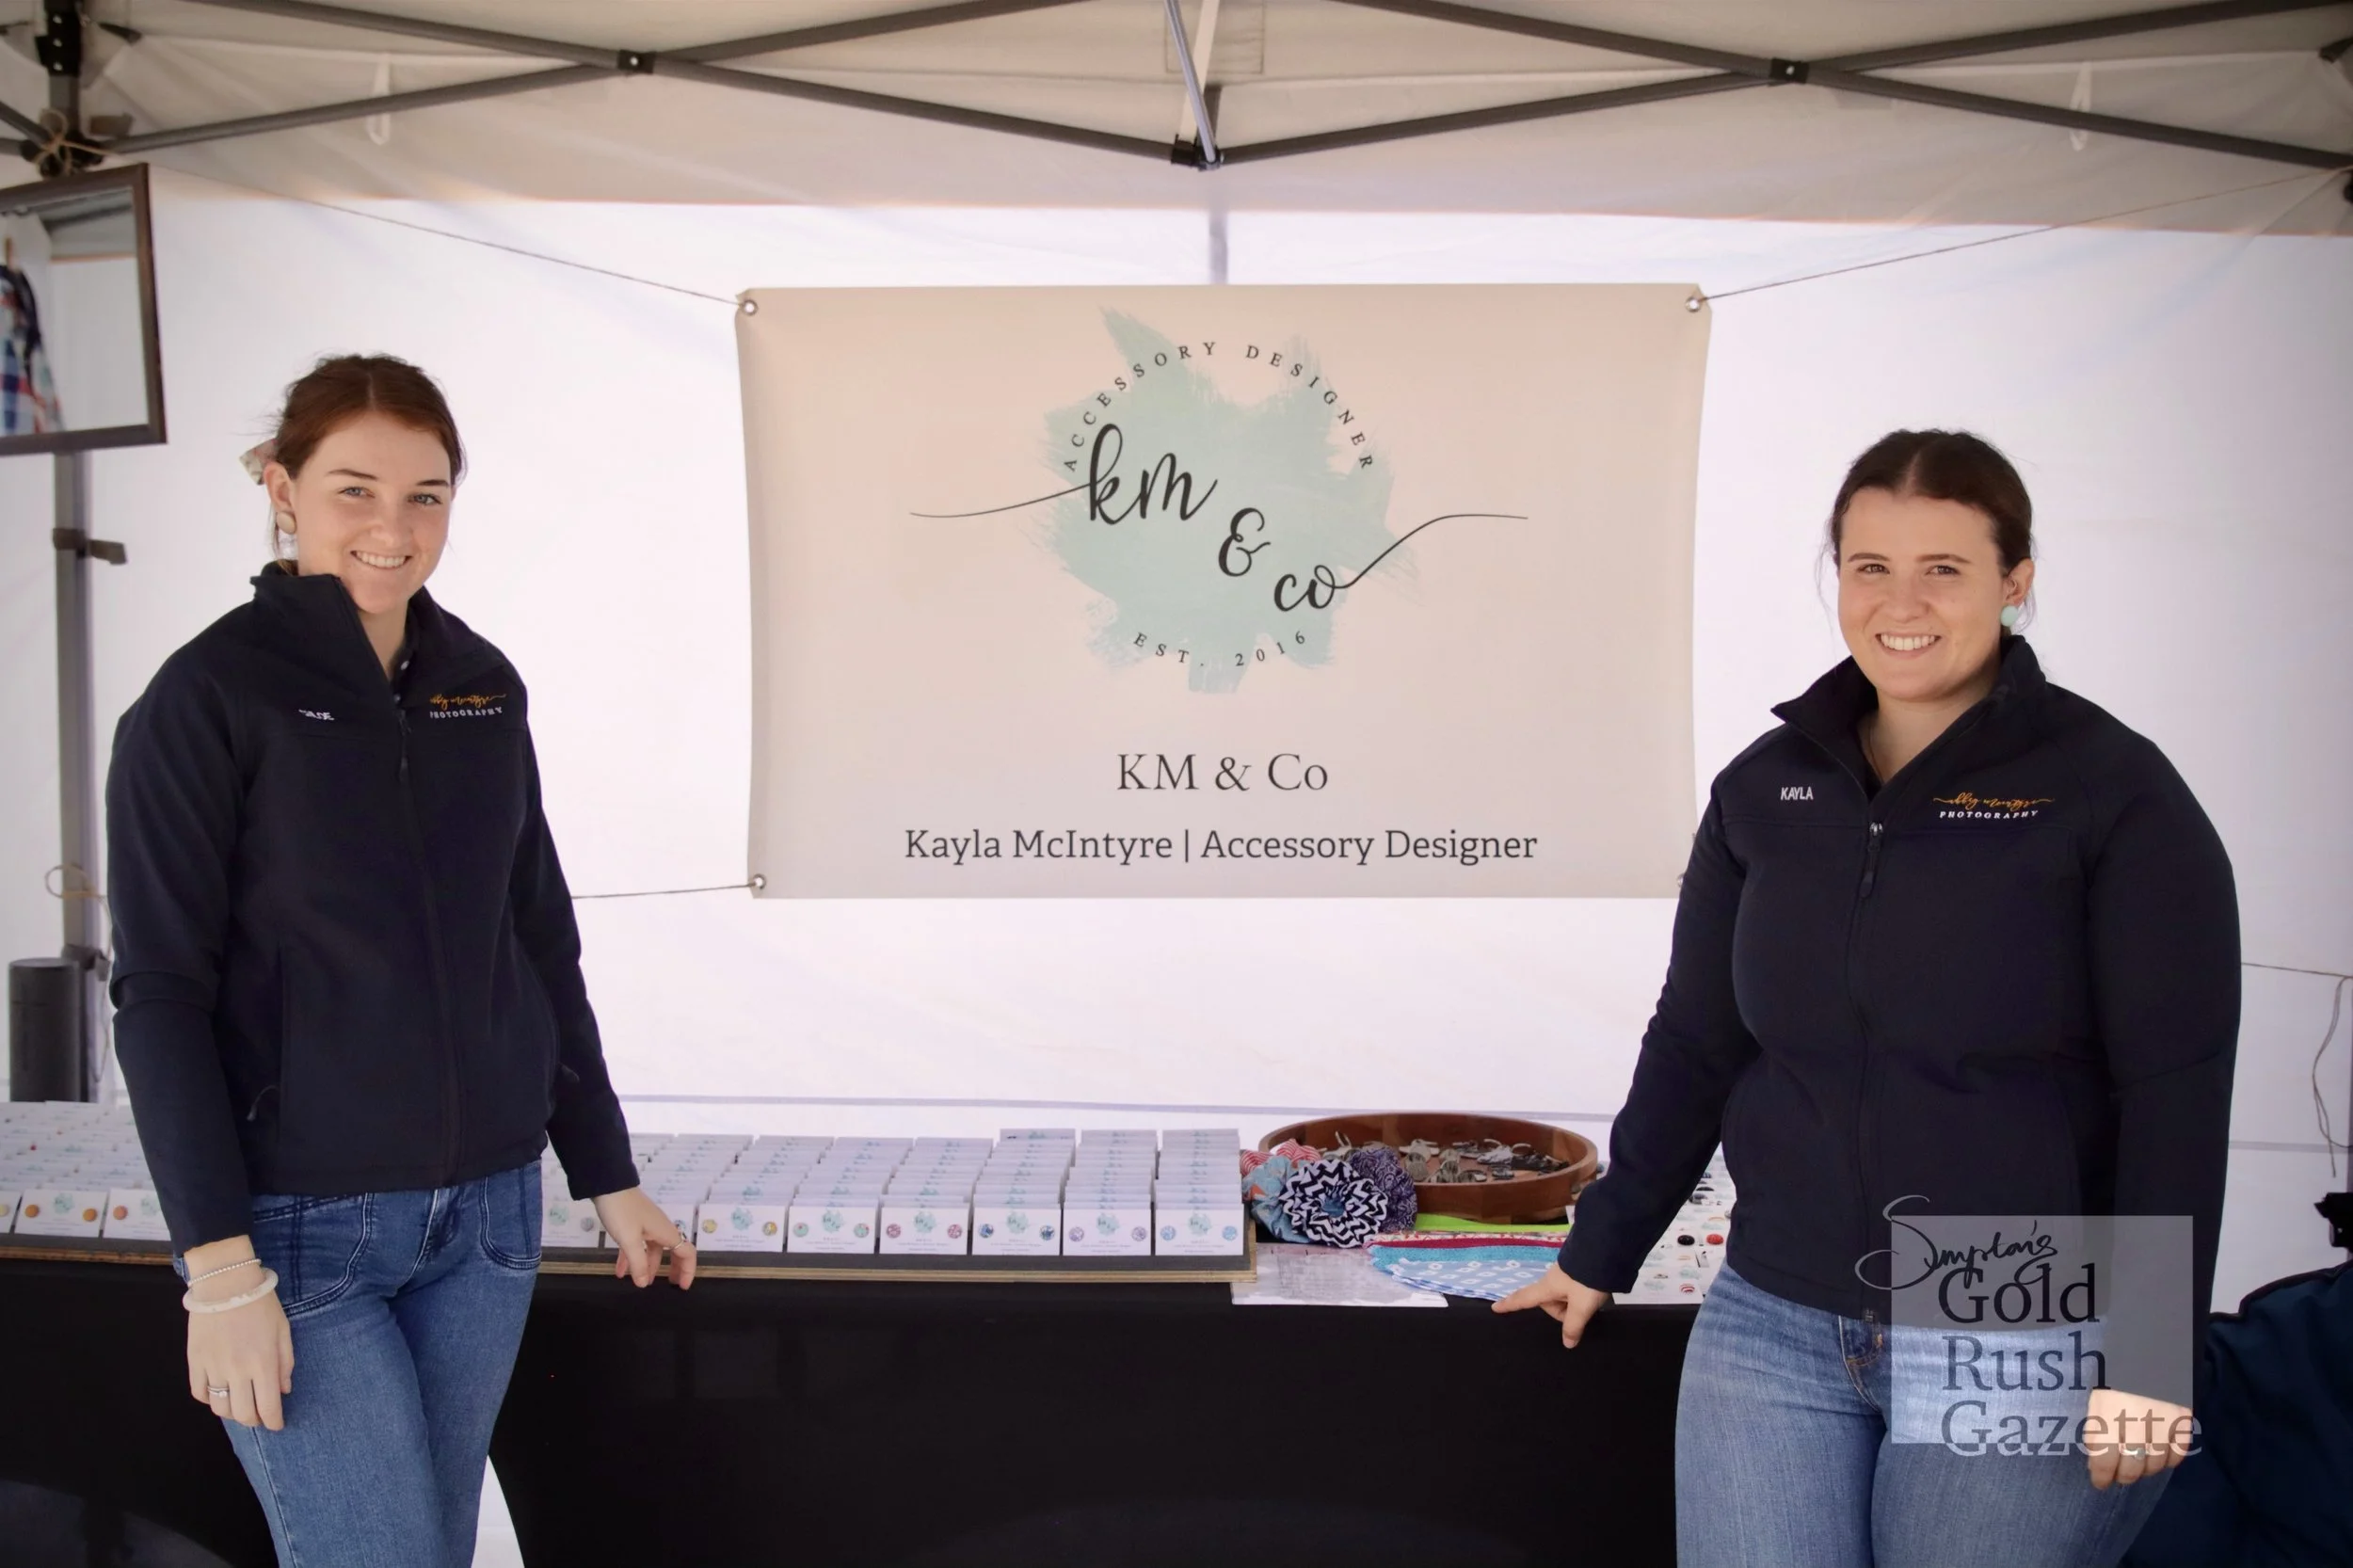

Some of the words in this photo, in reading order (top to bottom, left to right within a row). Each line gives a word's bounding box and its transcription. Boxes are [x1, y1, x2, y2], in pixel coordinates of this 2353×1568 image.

[1064, 342, 1215, 472] ACCESSORY
[1245, 344, 1373, 469] DESIGNER
[1218, 507, 1271, 577] &
[1133, 632, 1204, 666] EST.
[1235, 631, 1305, 667] 2016
[1117, 753, 1199, 791] KM
[1214, 756, 1252, 792] &
[1267, 753, 1328, 792] Co
[1781, 787, 1814, 801] KAYLA
[1939, 809, 2039, 820] PHOTOGRAPHY
[904, 828, 1002, 866] Kayla
[1012, 829, 1173, 866] McIntyre
[1200, 829, 1375, 867] Accessory
[1385, 828, 1538, 867] Designer
